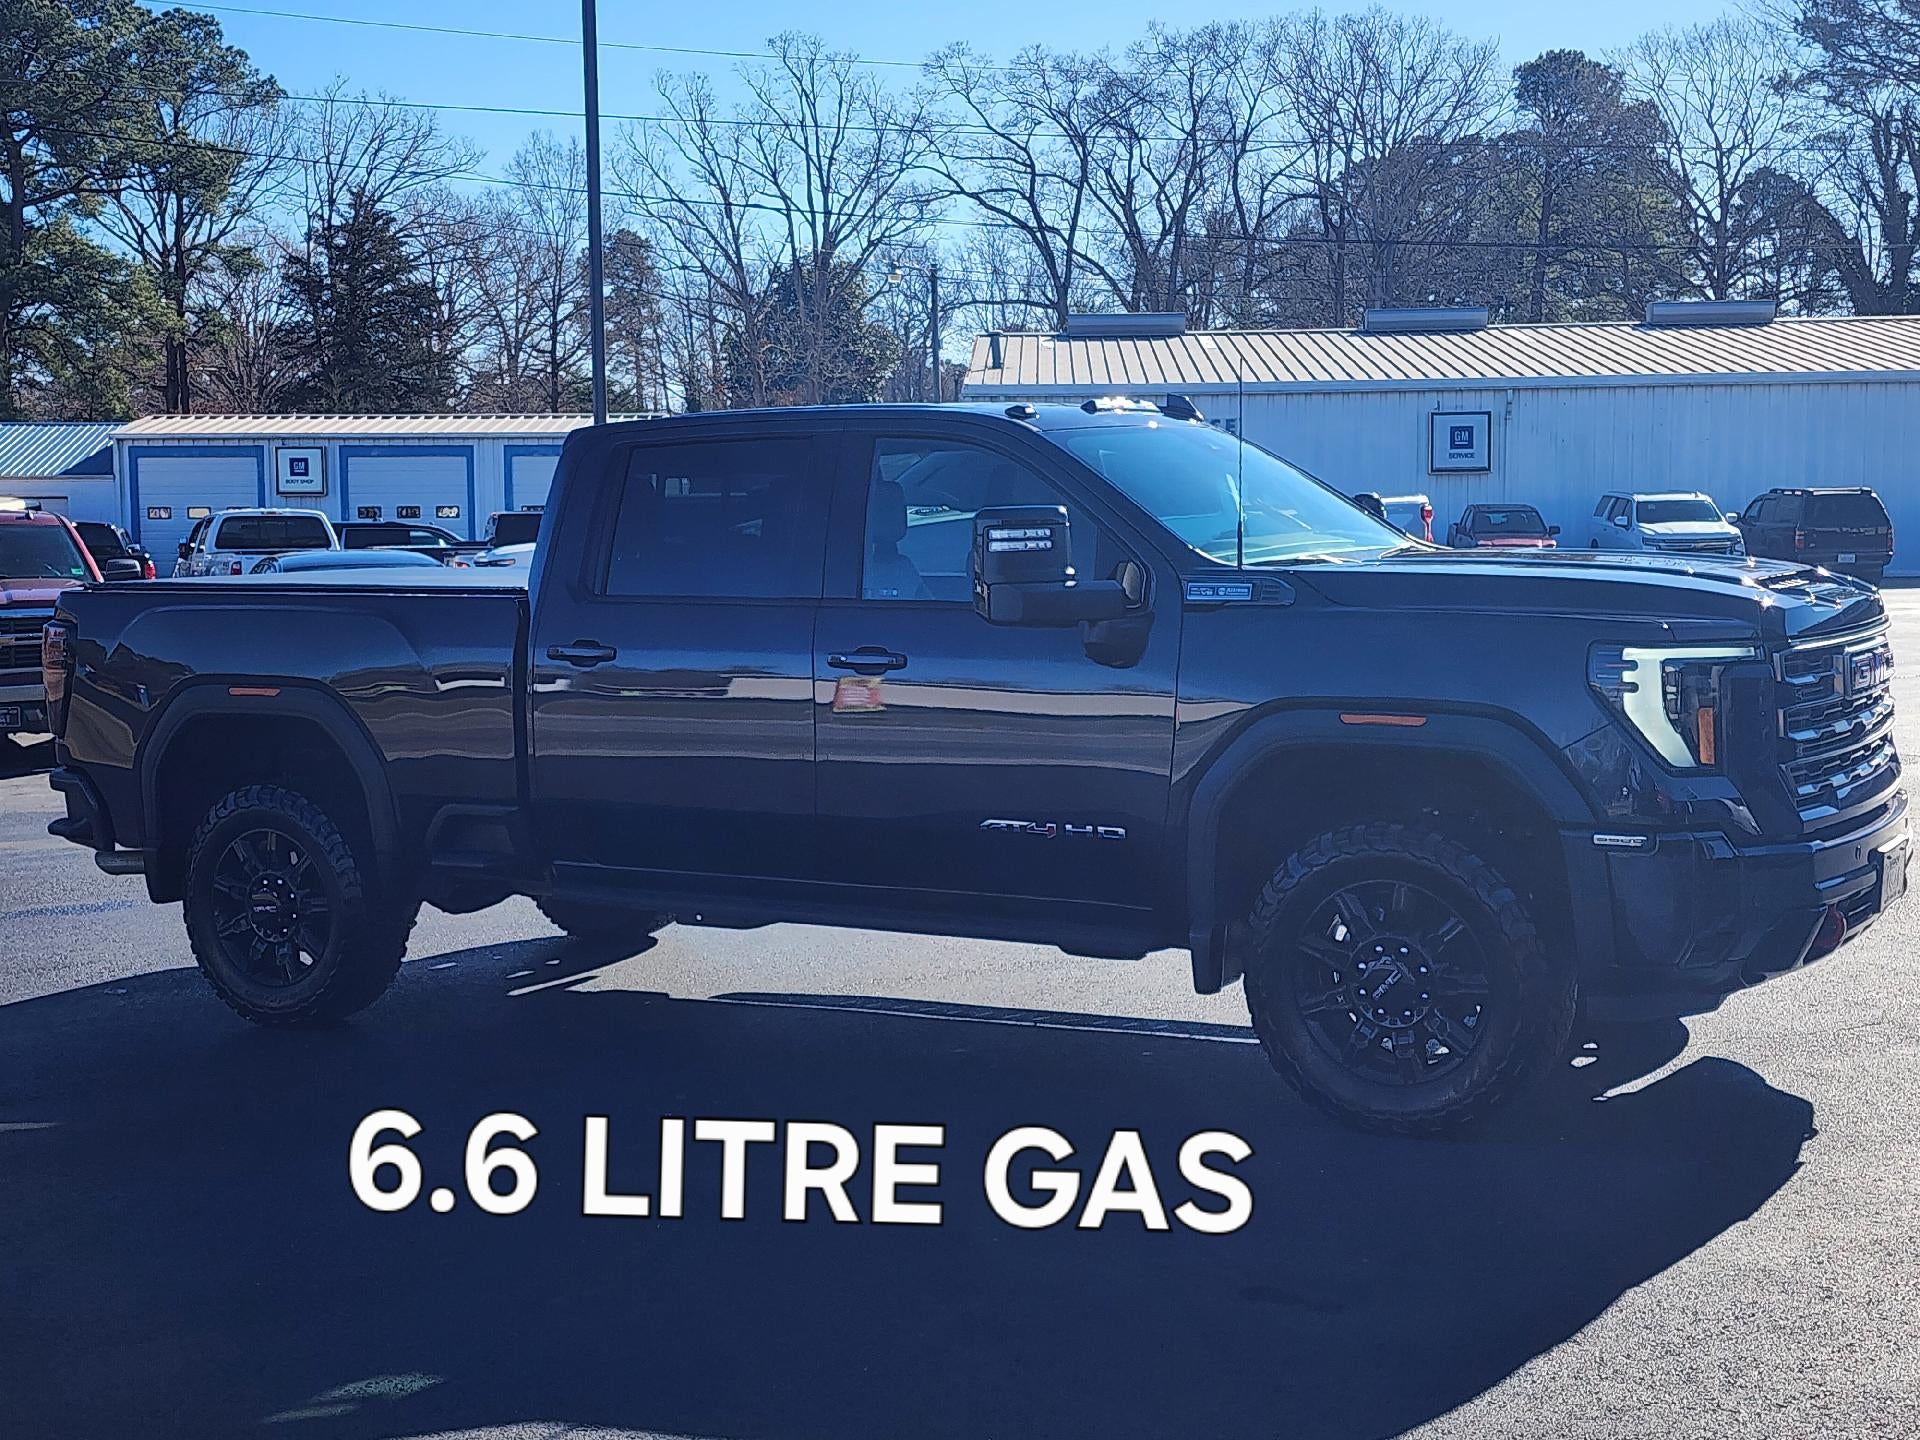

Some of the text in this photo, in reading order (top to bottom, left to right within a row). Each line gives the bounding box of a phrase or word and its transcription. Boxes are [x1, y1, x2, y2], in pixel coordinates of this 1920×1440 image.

[1448, 452, 1475, 460] SERVICE
[980, 819, 1127, 839] AT4 HD
